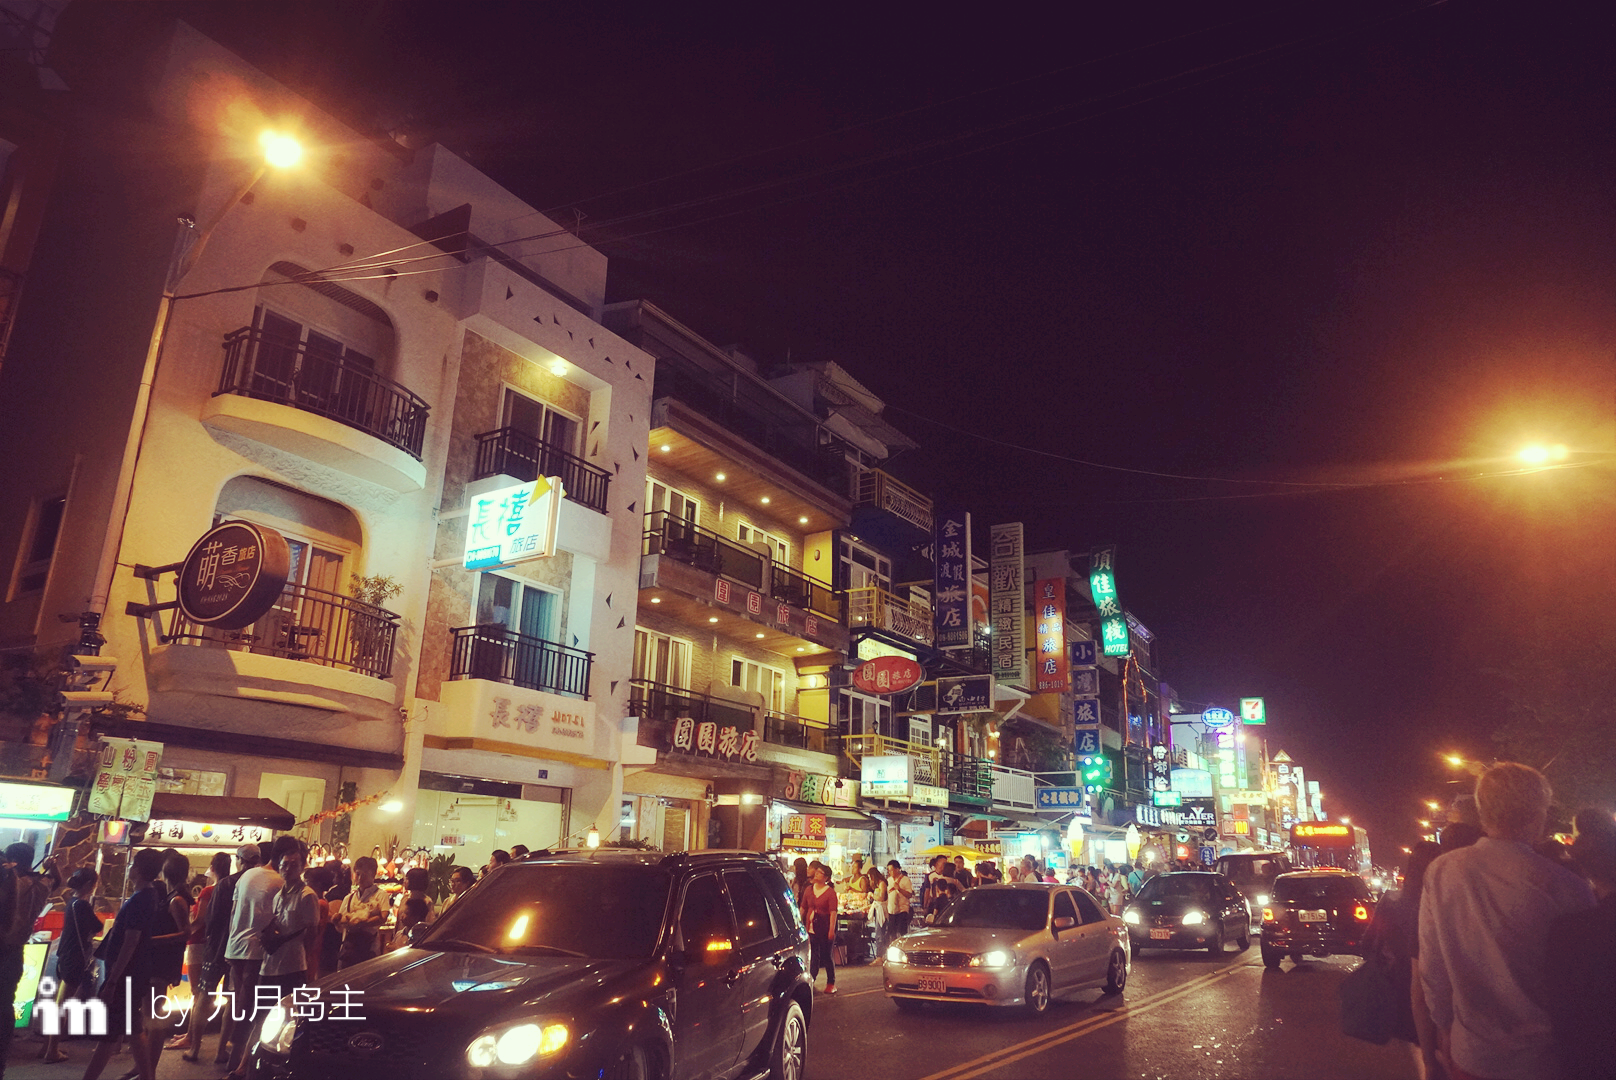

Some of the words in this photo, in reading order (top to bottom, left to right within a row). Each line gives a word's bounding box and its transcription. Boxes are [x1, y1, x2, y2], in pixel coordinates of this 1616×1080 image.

[510, 534, 539, 554] 旅店
[941, 519, 965, 627] 金城渡假旅店
[1037, 583, 1062, 675] 皇佳精品旅店
[1092, 549, 1126, 642] 頂佳旅棧
[1104, 643, 1129, 654] HOTEL
[1075, 644, 1096, 752] 小灣旅店
[788, 816, 822, 834] 拉茶
